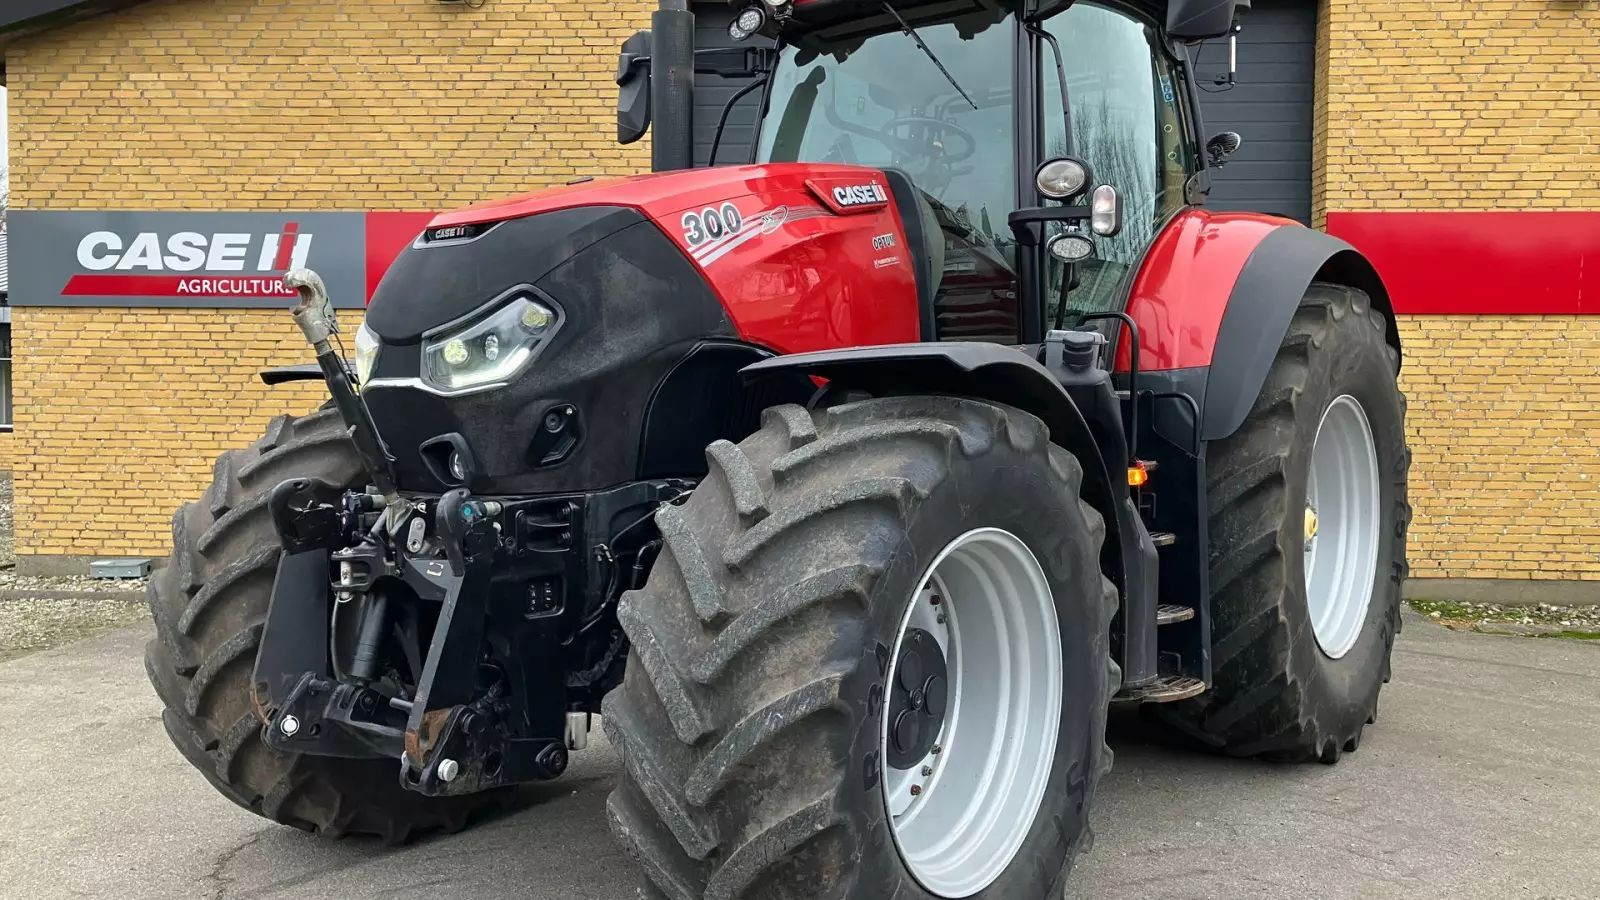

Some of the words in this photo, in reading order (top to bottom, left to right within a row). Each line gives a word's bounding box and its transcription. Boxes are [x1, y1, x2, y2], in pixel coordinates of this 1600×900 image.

[833, 185, 876, 205] CASE
[435, 227, 456, 239] CASE
[681, 202, 742, 246] 300
[76, 230, 251, 271] CASE
